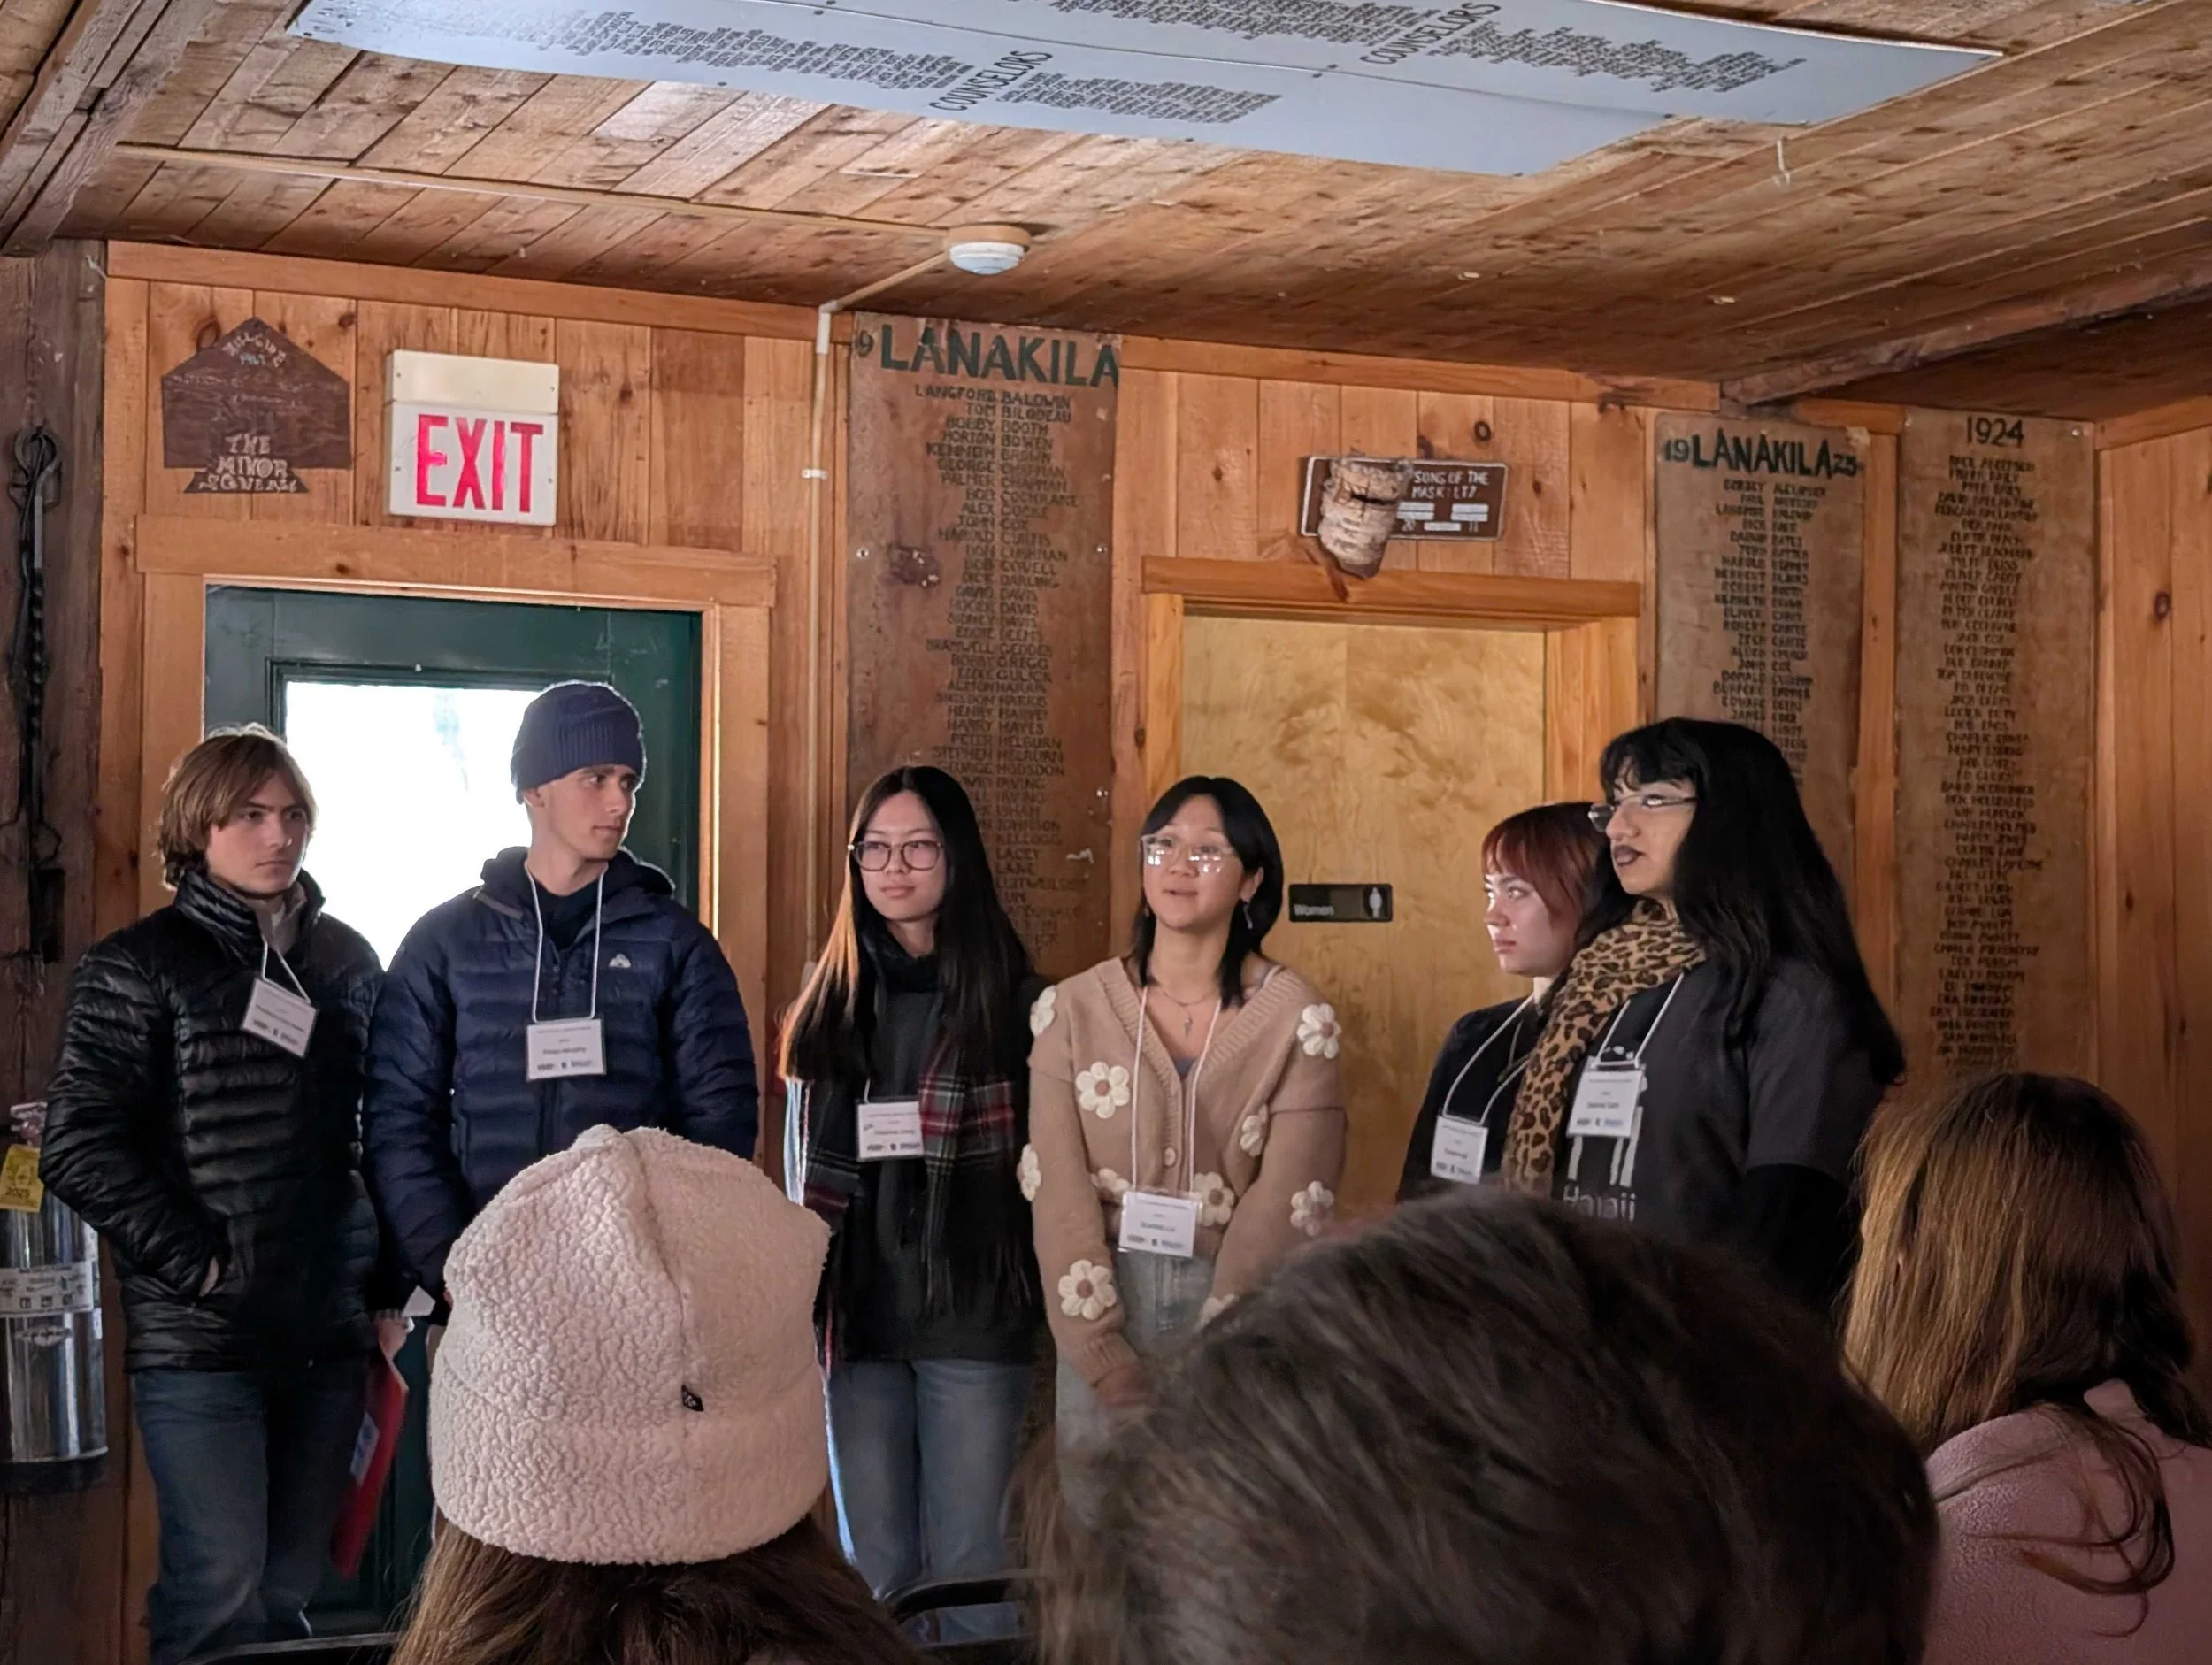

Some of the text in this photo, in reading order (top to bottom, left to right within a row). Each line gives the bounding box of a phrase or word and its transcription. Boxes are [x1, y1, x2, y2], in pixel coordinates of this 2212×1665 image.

[1359, 3, 1501, 65] COUNSELORS
[929, 50, 1053, 111] COUNSELORS
[880, 324, 1119, 388] LANAKILA
[914, 383, 1071, 409] LANGFORD BALDWIN
[966, 403, 1071, 423] TOM BILODEAU
[224, 433, 272, 455] THE
[1966, 417, 2024, 449] 1924
[216, 455, 288, 479] MINOR
[416, 413, 544, 513] EXIT
[1662, 439, 1690, 463] 19
[1692, 427, 1832, 479] LANAKILA
[1468, 470, 1490, 486] THE
